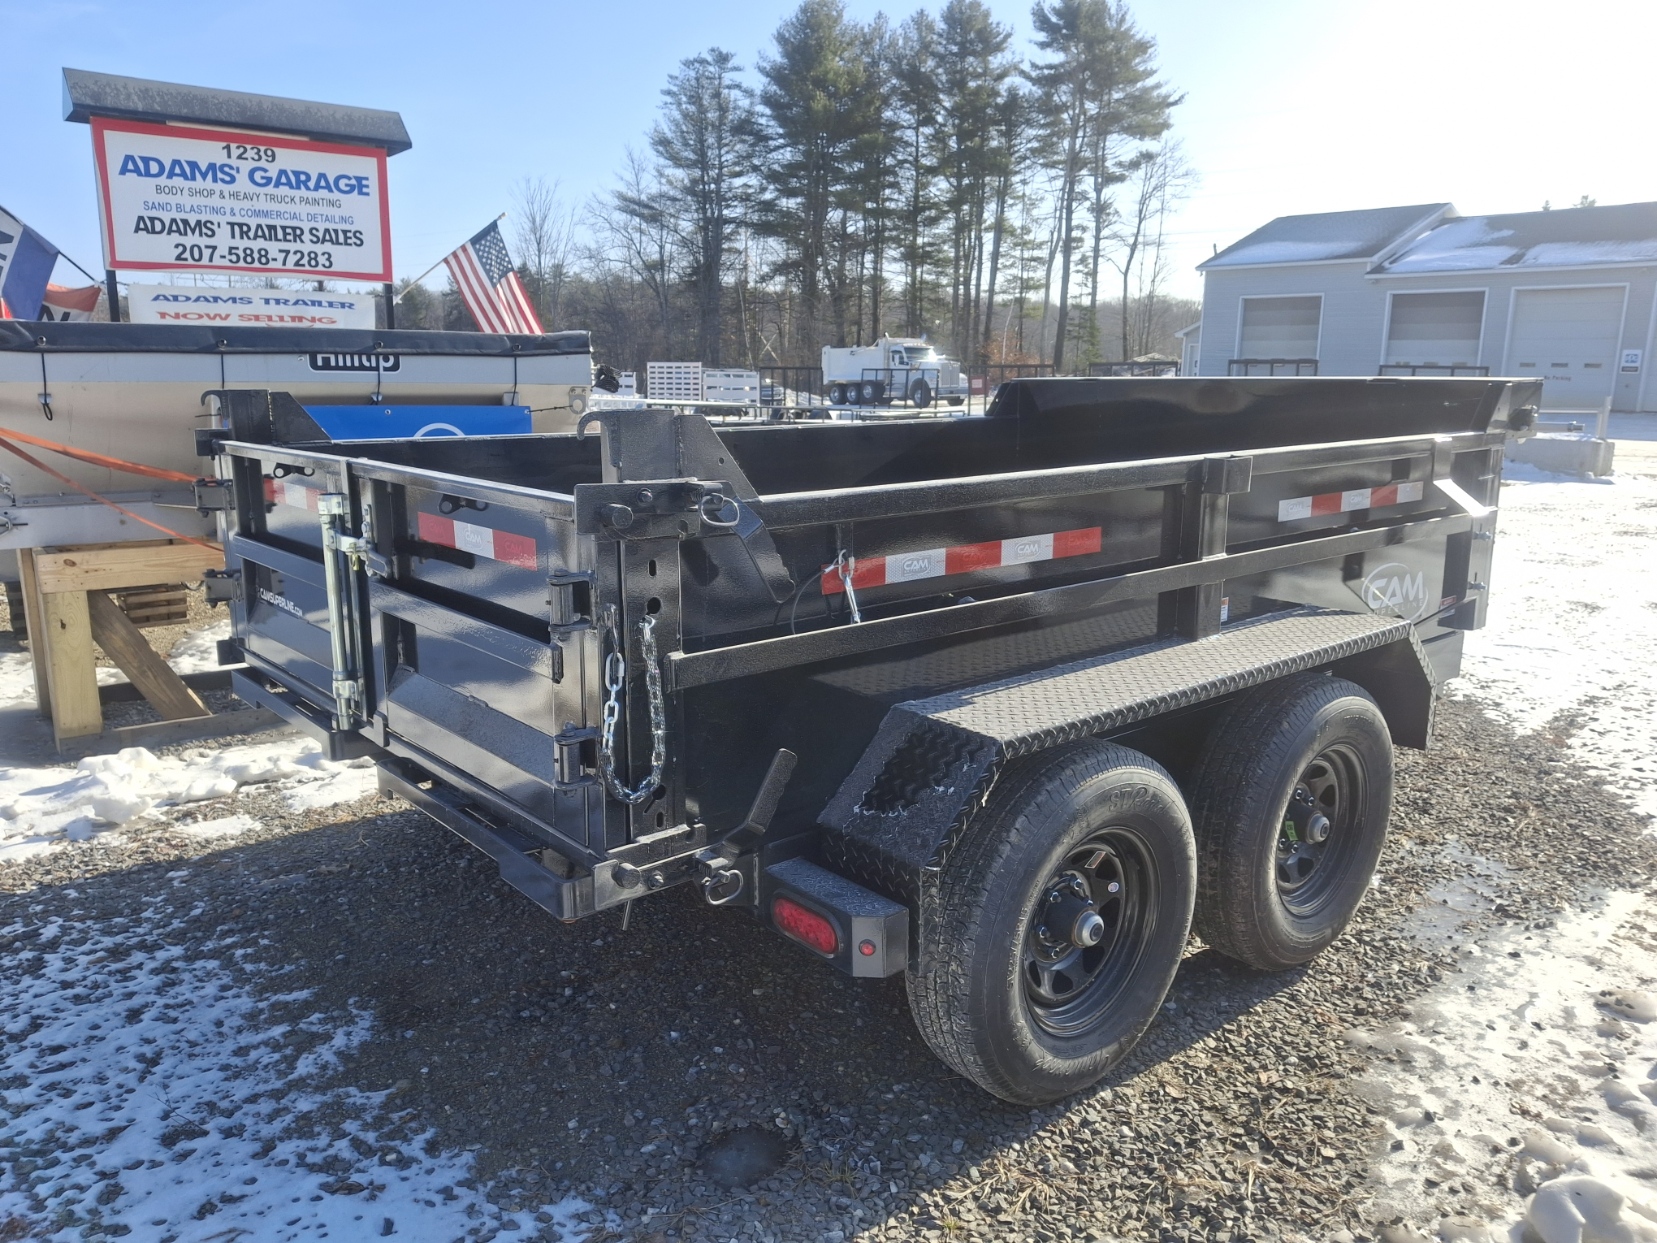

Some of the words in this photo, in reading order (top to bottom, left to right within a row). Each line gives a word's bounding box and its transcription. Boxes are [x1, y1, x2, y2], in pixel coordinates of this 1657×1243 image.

[221, 143, 276, 163] 1239
[118, 154, 241, 185] ADAMS'
[247, 166, 371, 196] GARAGE
[155, 184, 185, 196] BODY
[188, 186, 216, 199] SHOP
[218, 189, 226, 200] &
[228, 190, 261, 202] HEAVY
[263, 193, 297, 205] TRUCK
[299, 195, 342, 209] PAINTING
[143, 200, 172, 212] SAND
[175, 202, 227, 217] BLASTING
[229, 206, 237, 217] &
[238, 207, 304, 222] COMMERCIAL
[306, 212, 354, 225] DETAILING
[133, 215, 222, 238] ADAMS'
[227, 221, 305, 243] TRAILER
[308, 227, 365, 247] SALES
[174, 243, 334, 269] 207-588-7283
[151, 294, 254, 305] ADAMS
[259, 297, 356, 310] TRAILER
[156, 311, 231, 321] NOW
[238, 313, 338, 324] SELLING
[1017, 543, 1039, 554] CAM
[903, 558, 930, 571] CAM
[1367, 570, 1424, 609] CAM
